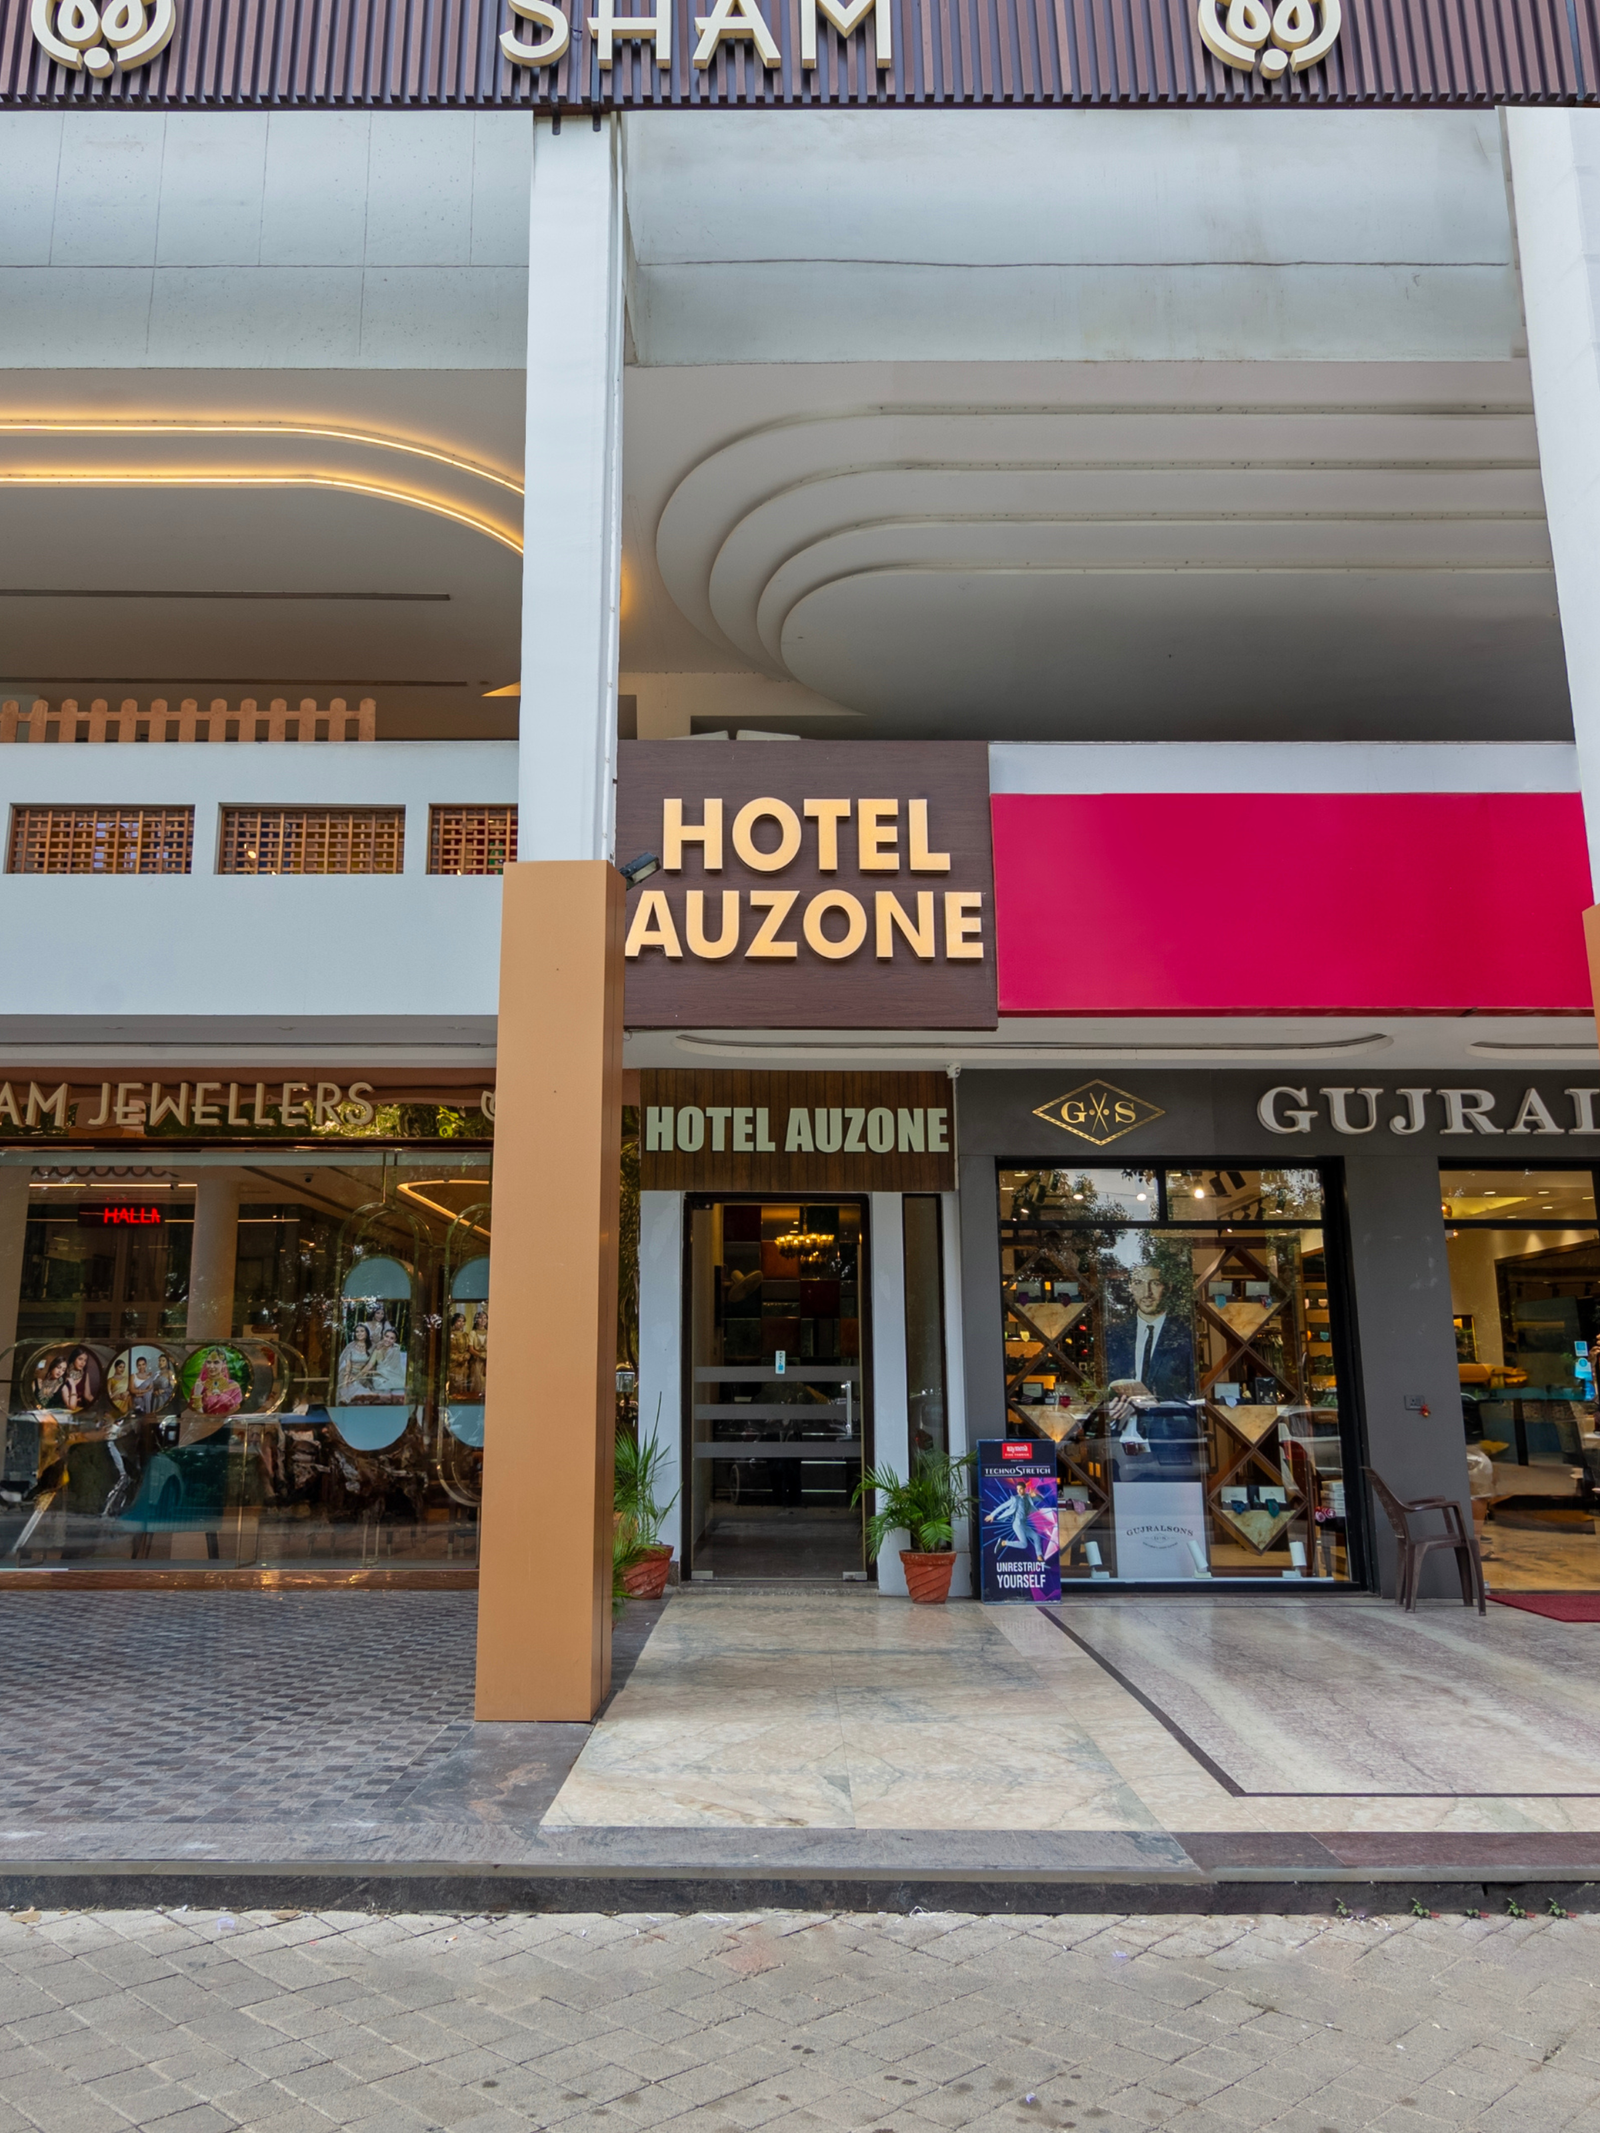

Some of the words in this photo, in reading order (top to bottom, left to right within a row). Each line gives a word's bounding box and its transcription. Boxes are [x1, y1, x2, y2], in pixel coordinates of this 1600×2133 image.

[499, 0, 892, 69] SHAM
[662, 797, 951, 873] HOTEL
[625, 889, 984, 960] AUZONE
[88, 1082, 375, 1127] JEWELLERS
[646, 1106, 776, 1152] HOTEL
[785, 1107, 949, 1153] AUZONE
[1126, 1525, 1194, 1537] GUJRALSONS
[996, 1561, 1046, 1573] UNRESTRICT
[996, 1574, 1047, 1589] YOURSELF
